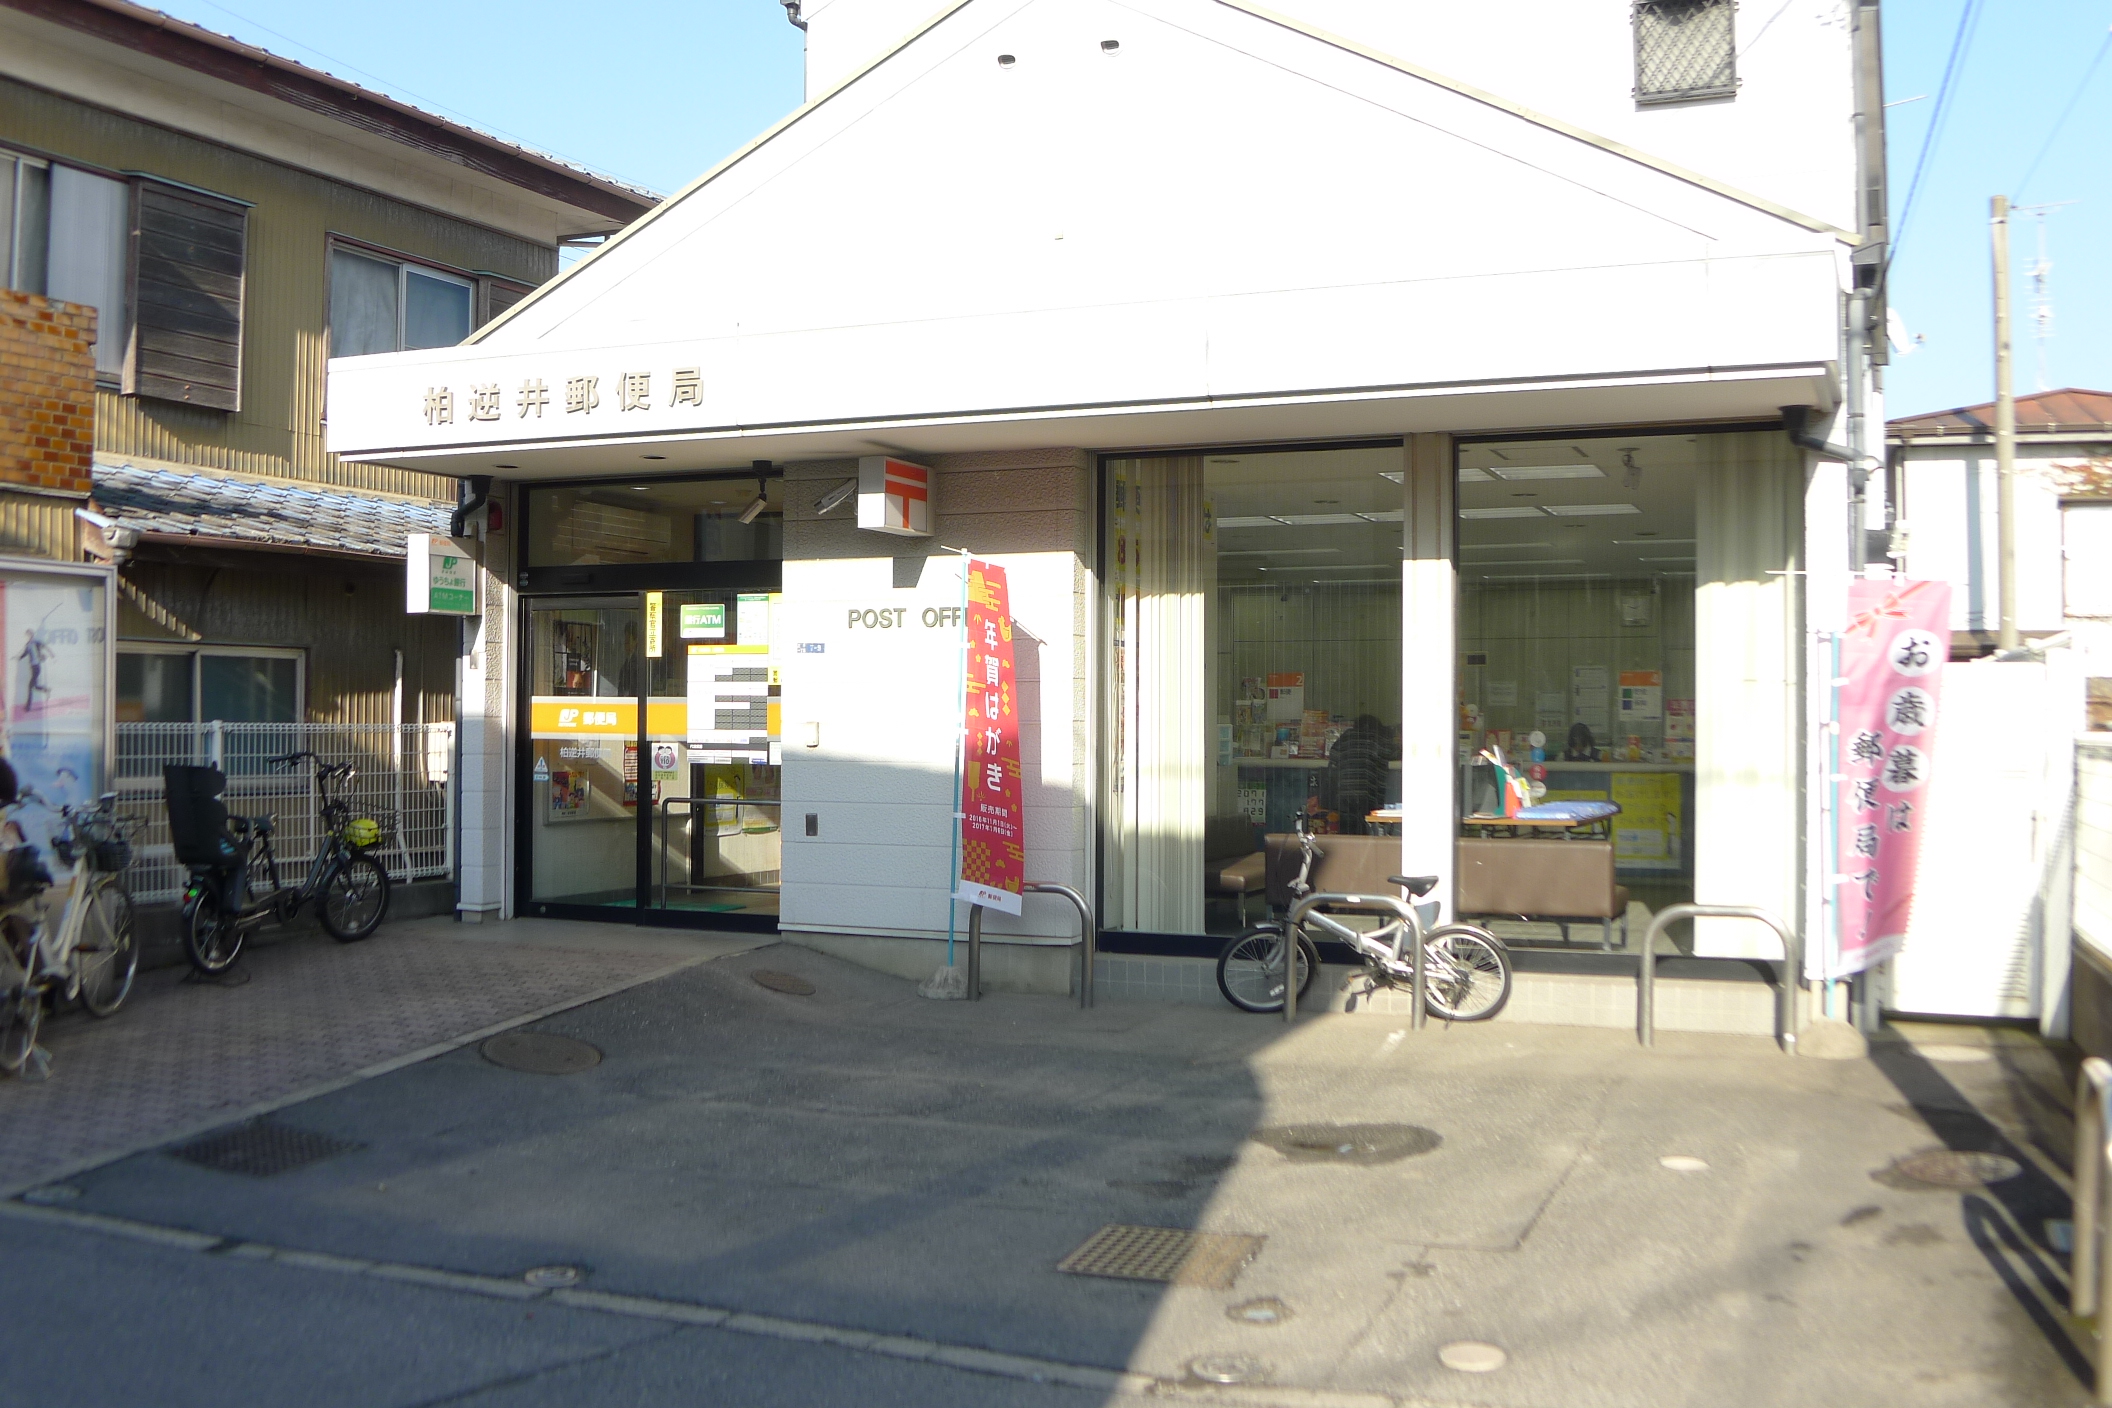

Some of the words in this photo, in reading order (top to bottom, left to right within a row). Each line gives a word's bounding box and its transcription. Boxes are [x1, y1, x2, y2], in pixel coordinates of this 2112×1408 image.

[423, 366, 704, 425] 柏逆井郵便局
[848, 608, 907, 629] POST
[984, 618, 1003, 792] 年賀はがき
[980, 803, 1008, 818] 販売期間
